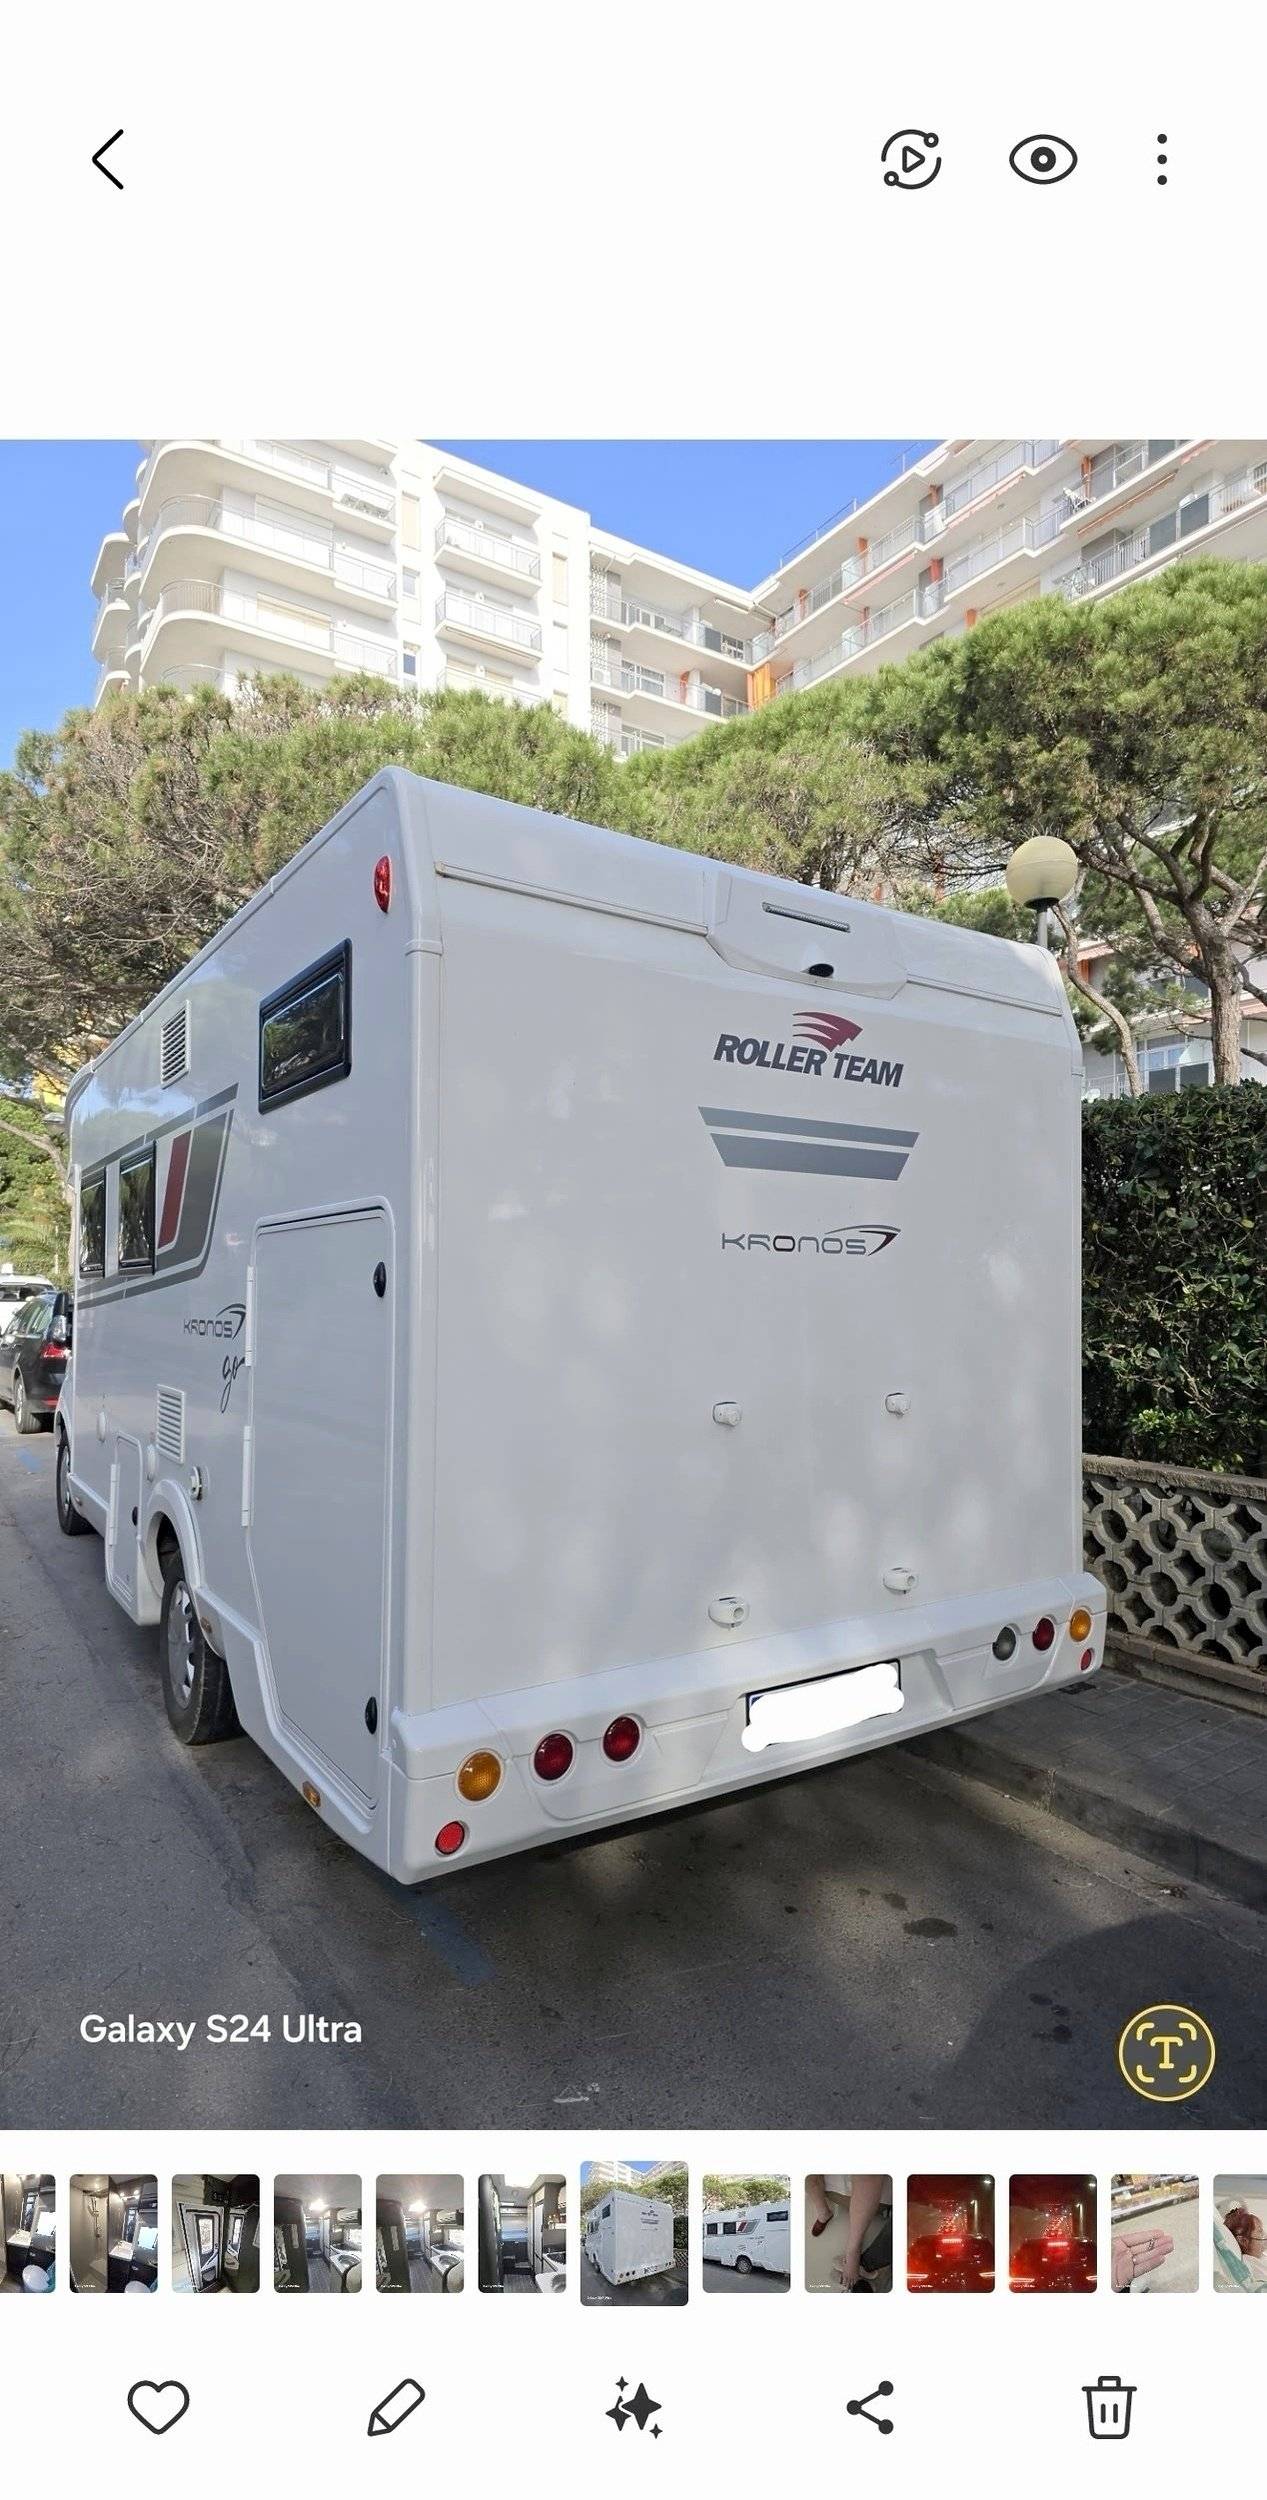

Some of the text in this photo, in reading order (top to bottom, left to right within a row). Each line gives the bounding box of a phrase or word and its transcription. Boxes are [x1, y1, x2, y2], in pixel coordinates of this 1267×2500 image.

[713, 1034, 904, 1088] ROLLER TEAM
[721, 1232, 867, 1255] KRONOS
[183, 1318, 233, 1339] KRONOS
